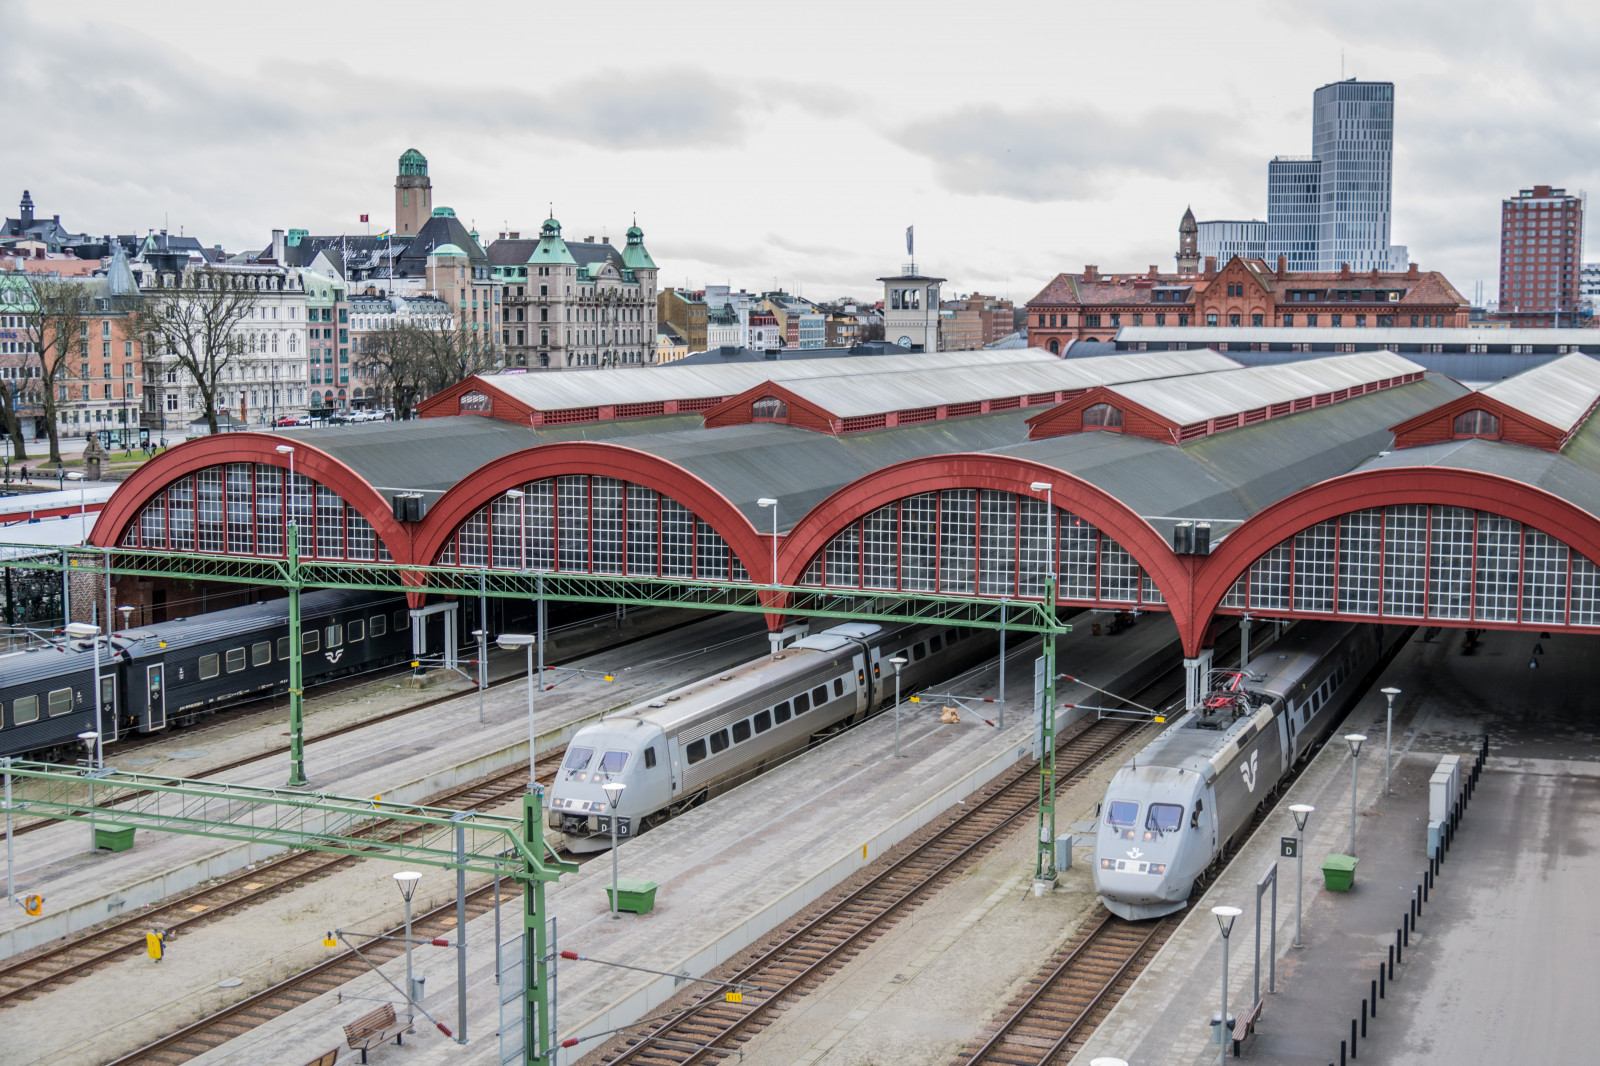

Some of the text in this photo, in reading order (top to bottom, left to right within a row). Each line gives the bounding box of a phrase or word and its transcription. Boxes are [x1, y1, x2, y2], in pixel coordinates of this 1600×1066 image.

[601, 824, 608, 832] D
[621, 826, 628, 834] D
[1285, 847, 1293, 855] D
